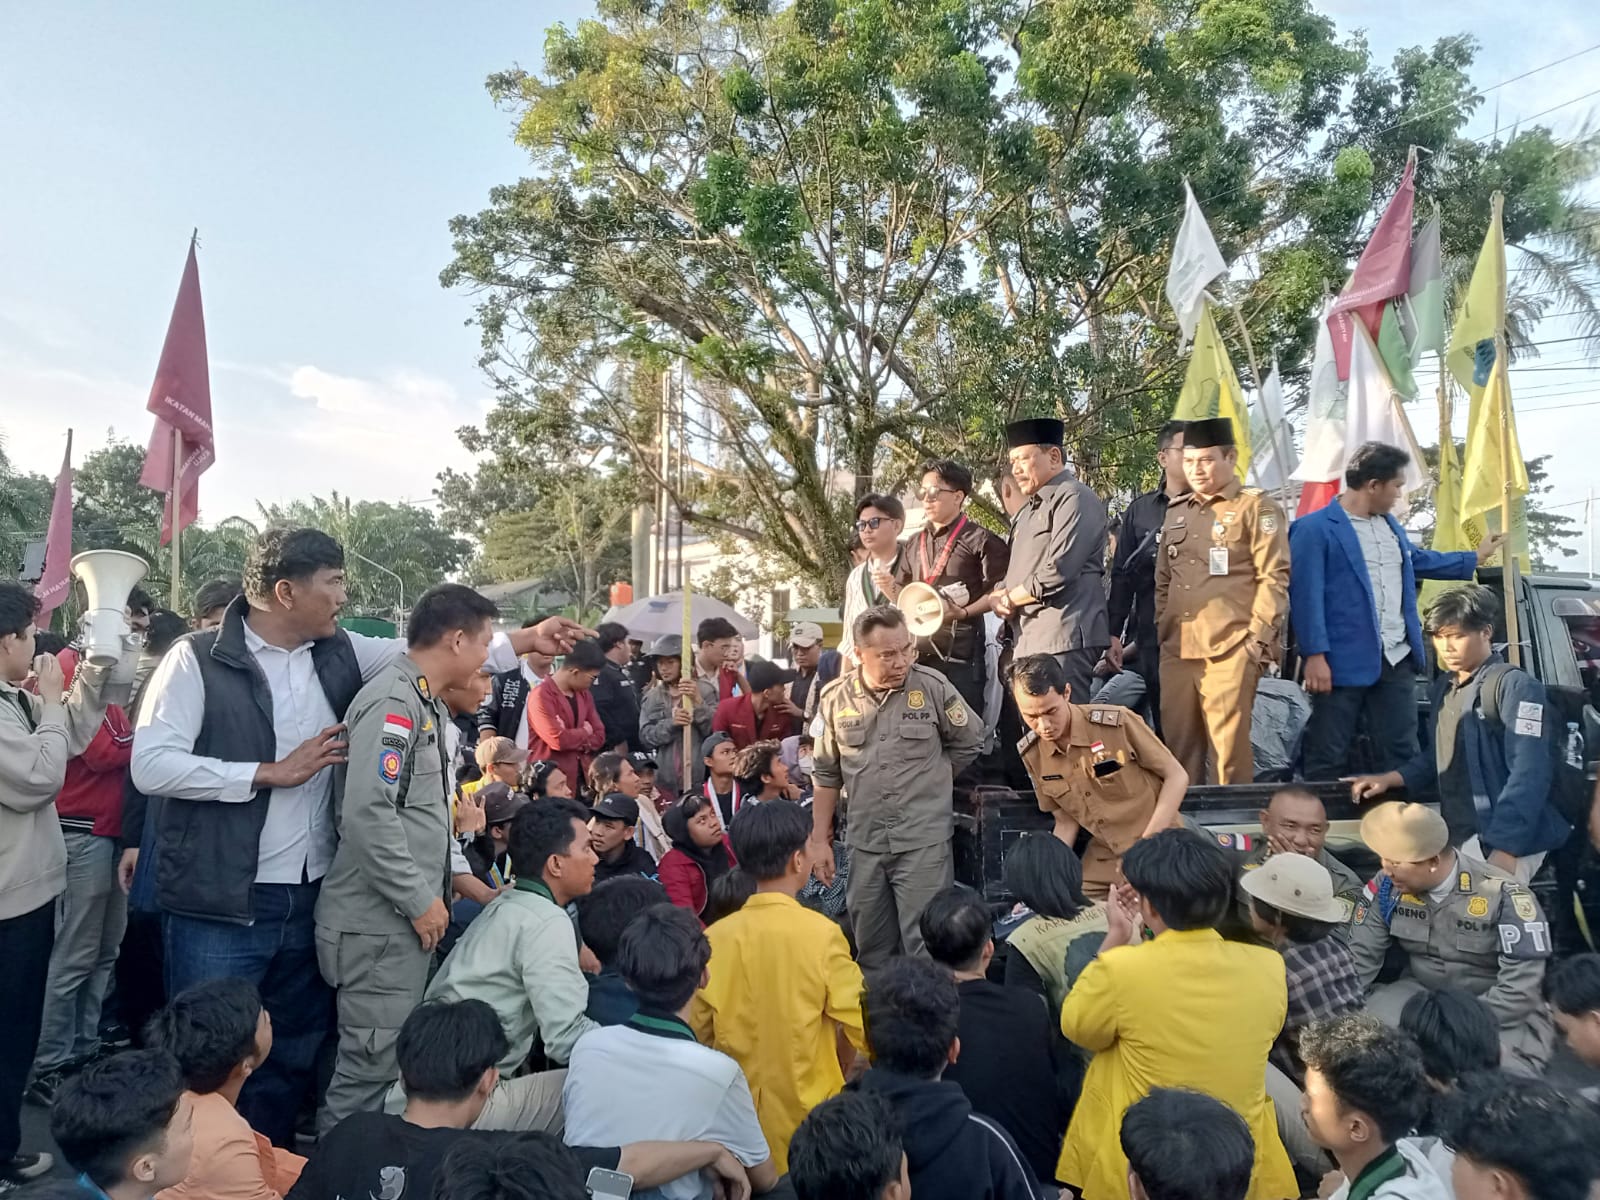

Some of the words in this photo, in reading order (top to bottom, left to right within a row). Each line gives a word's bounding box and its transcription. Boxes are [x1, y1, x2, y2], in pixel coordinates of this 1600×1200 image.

[164, 396, 195, 418] IKATAN
[902, 712, 918, 720] POL
[1456, 920, 1479, 932] POL
